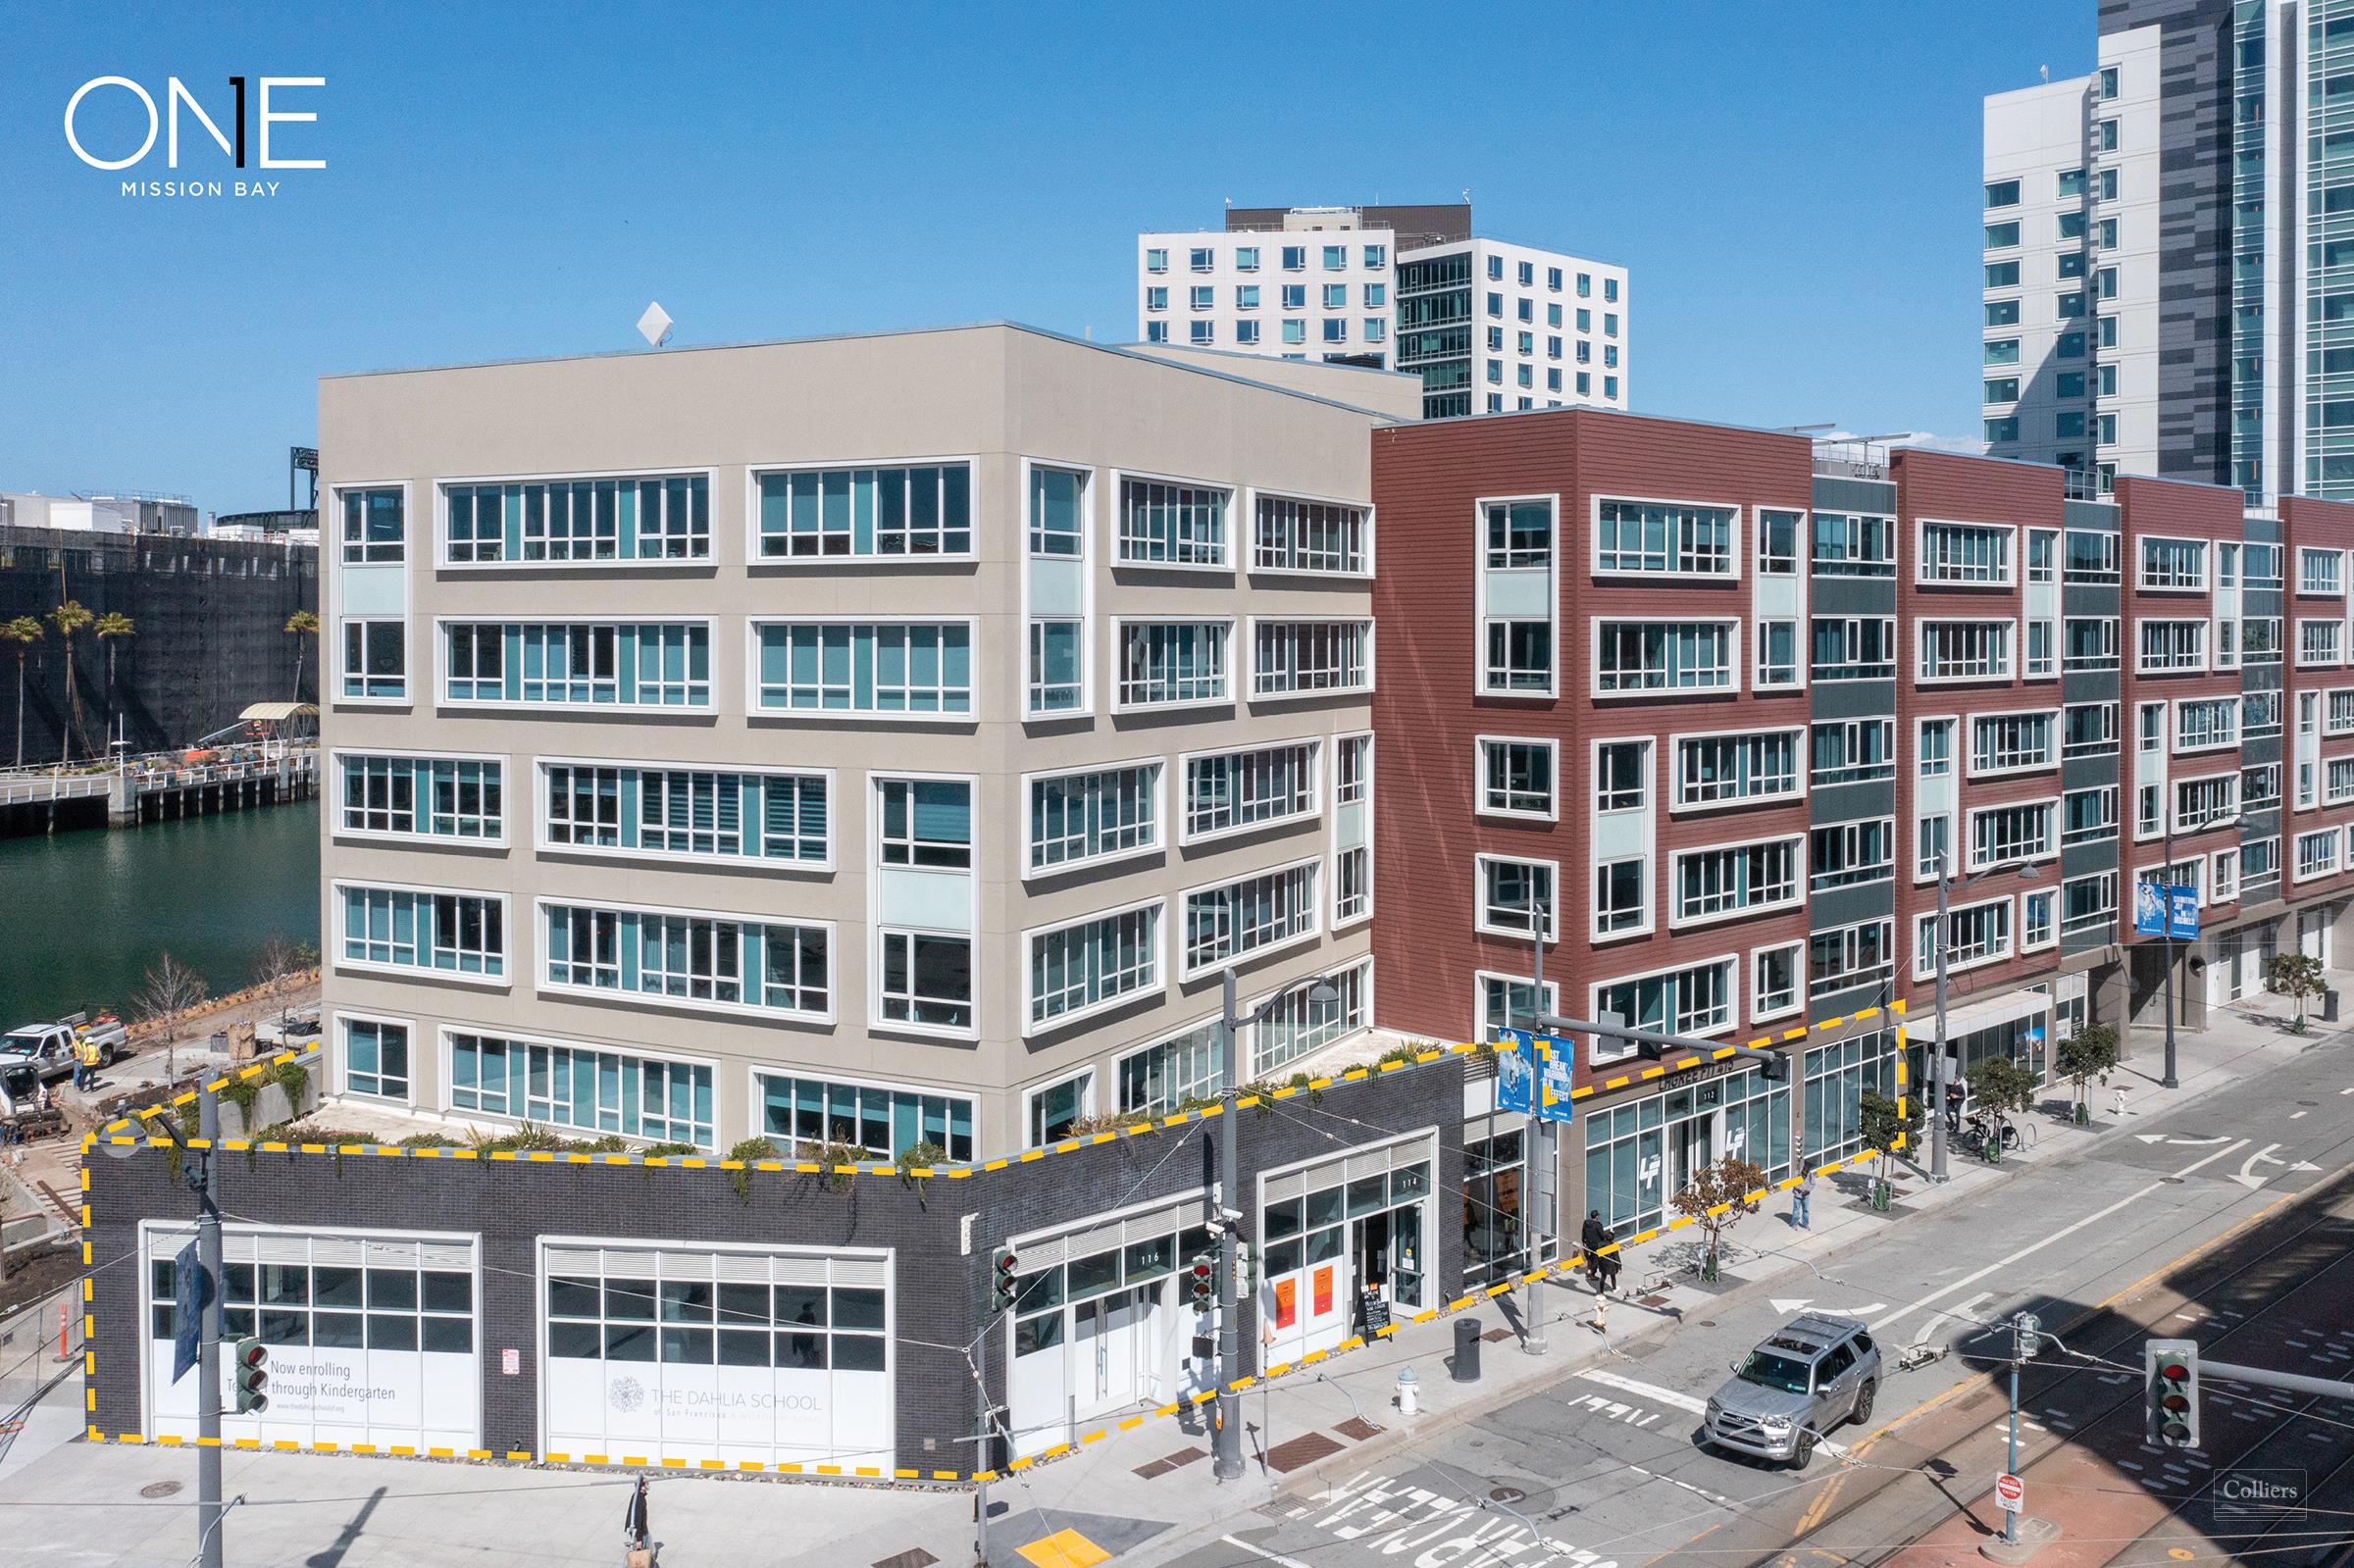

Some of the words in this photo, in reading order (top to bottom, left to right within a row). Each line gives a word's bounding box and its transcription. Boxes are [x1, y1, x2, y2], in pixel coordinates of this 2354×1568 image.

[1704, 1090, 1714, 1100] 112
[1403, 1177, 1417, 1189] 114
[1142, 1251, 1159, 1265] 116
[271, 1360, 295, 1374] Now
[299, 1361, 351, 1381] enrolling
[272, 1380, 317, 1399] through
[321, 1383, 395, 1403] Kindergarten
[651, 1389, 683, 1404] THE
[688, 1391, 746, 1407] DAHLIA
[750, 1393, 822, 1411] SCHOOL
[686, 1410, 727, 1420] Francisco
